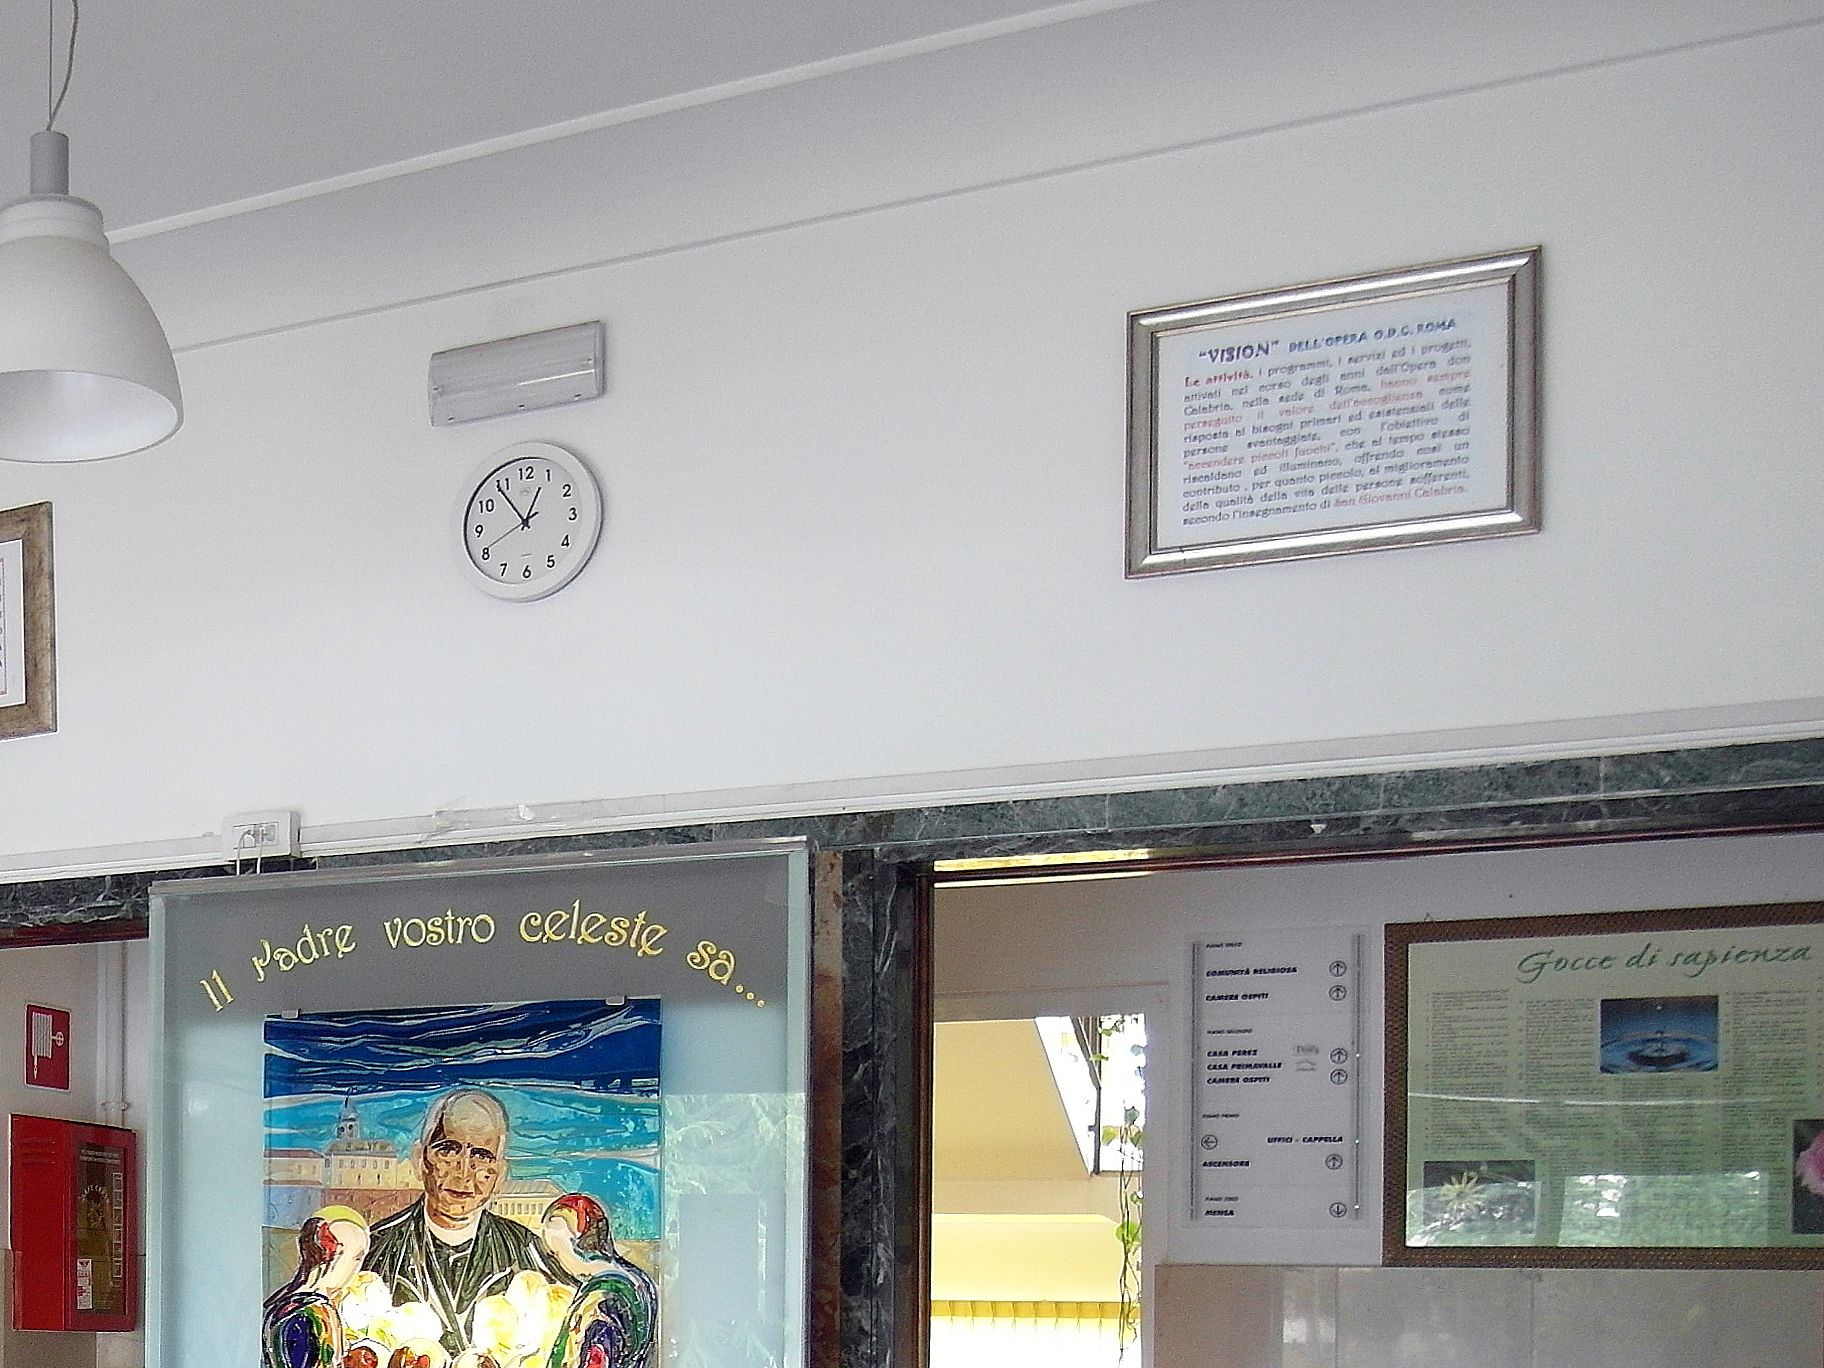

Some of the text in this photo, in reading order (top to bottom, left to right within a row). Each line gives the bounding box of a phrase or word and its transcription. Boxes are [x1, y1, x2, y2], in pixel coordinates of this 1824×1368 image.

[1289, 331, 1367, 353] DELL'OPERA
[1417, 318, 1456, 333] ROMA
[1184, 445, 1228, 458] persone
[518, 466, 535, 481] 12
[545, 468, 552, 482] 1
[496, 476, 510, 492] 11
[1274, 475, 1315, 488] quanto
[562, 483, 573, 498] 2
[478, 498, 495, 514] 10
[568, 507, 578, 521] 3
[1183, 512, 1230, 525] secondo
[475, 524, 484, 538] 9
[561, 534, 570, 548] 4
[481, 546, 491, 561] 8
[546, 554, 556, 569] 5
[499, 563, 509, 577] 7
[522, 565, 532, 579] 6
[199, 969, 235, 1014] Il
[383, 908, 497, 949] vostro
[518, 900, 669, 959] celeste
[685, 938, 768, 1010] sa...
[1516, 942, 1814, 984] Gocce di sapienza
[1253, 966, 1297, 975] RELIGIOSA
[1231, 1049, 1258, 1057] PEREZ
[1207, 1063, 1228, 1071] CASA
[1207, 1076, 1240, 1085] CAMERE
